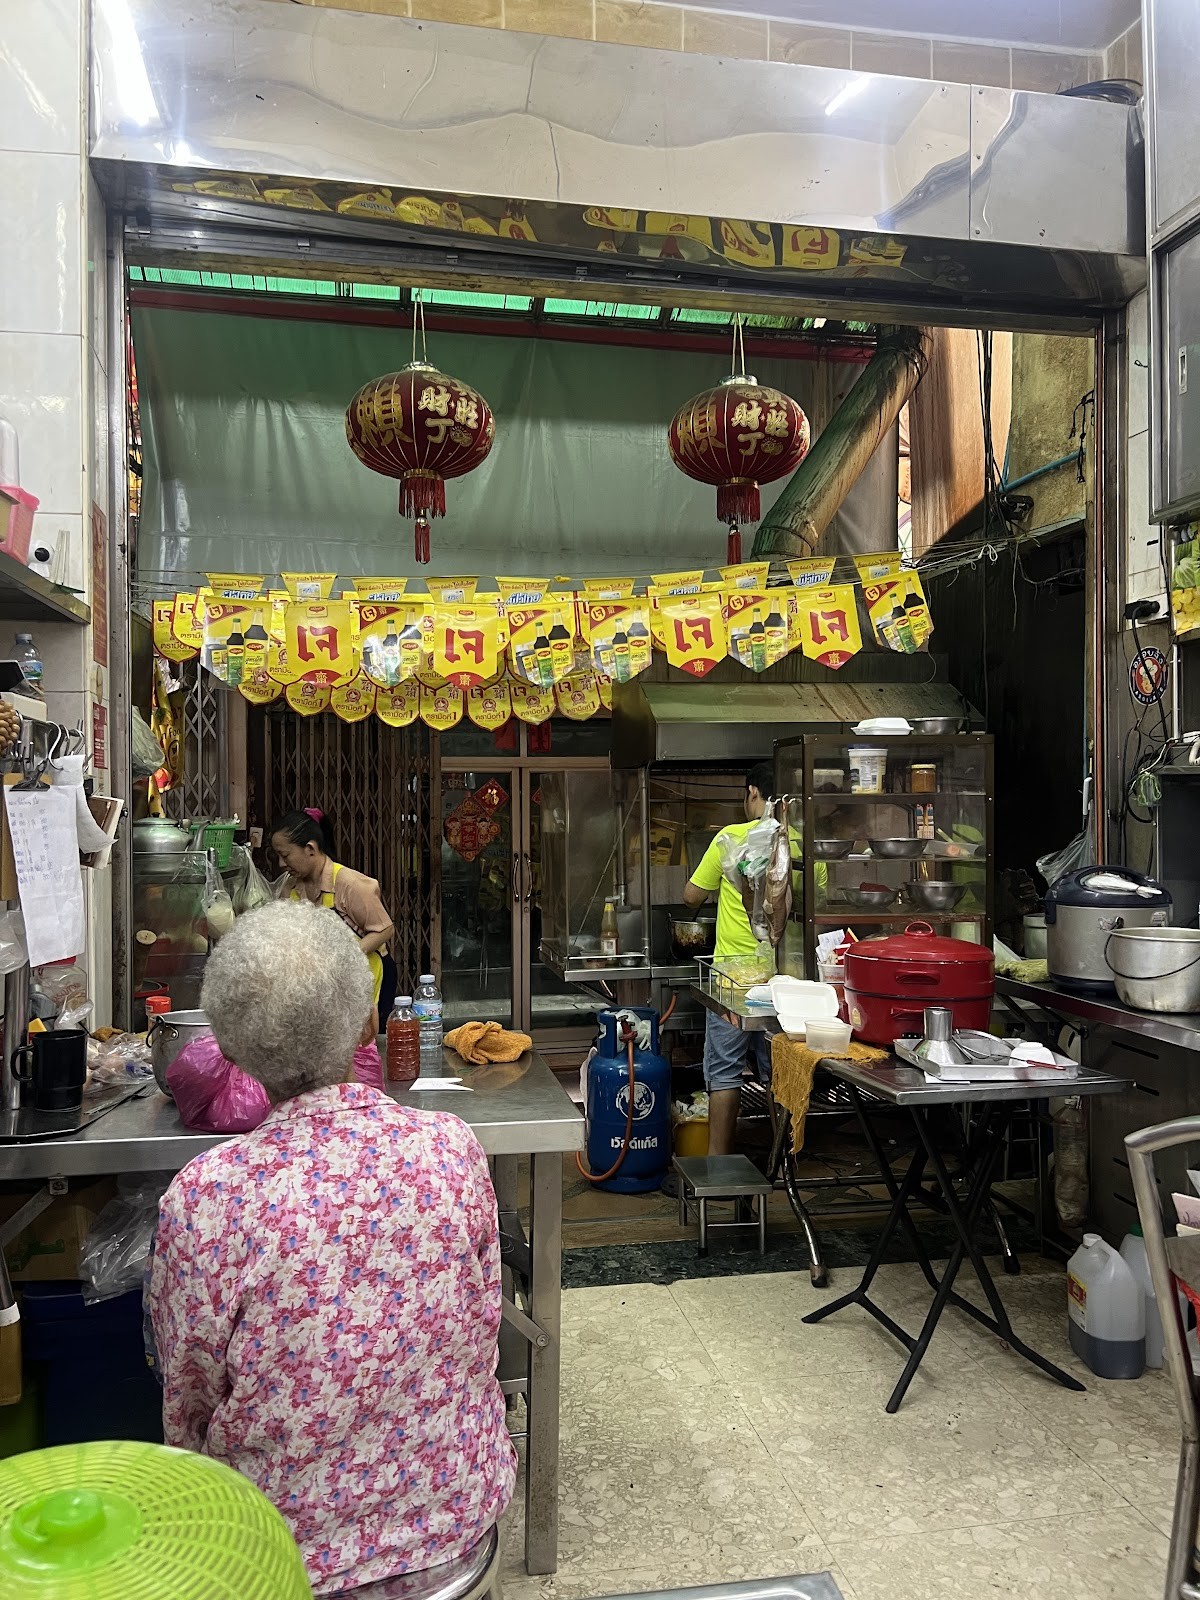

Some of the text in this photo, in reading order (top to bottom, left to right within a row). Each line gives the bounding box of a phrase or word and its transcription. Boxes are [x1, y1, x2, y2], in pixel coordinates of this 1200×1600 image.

[297, 625, 340, 662] เจ
[673, 617, 714, 652] เจ
[809, 610, 849, 644] เจ
[445, 628, 485, 665] เจ
